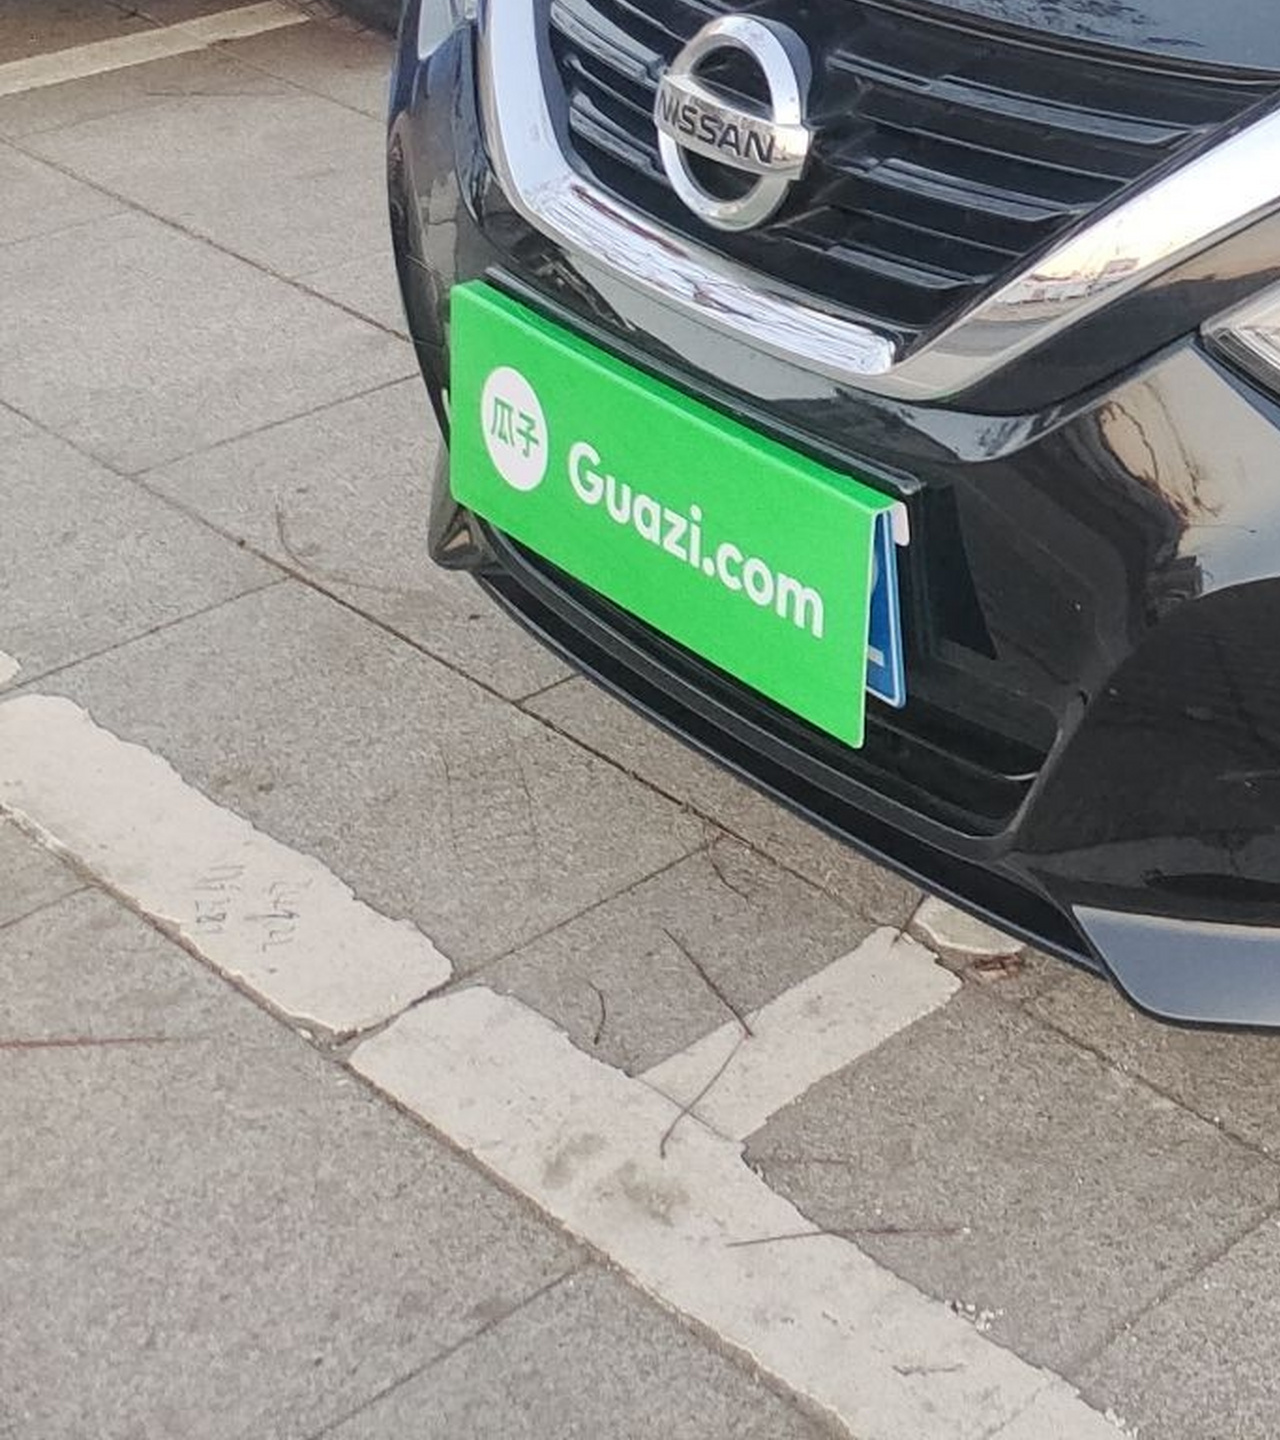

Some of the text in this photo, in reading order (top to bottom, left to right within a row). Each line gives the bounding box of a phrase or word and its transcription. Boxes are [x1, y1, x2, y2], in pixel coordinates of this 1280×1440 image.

[655, 86, 776, 166] NISSAN
[489, 394, 541, 460] 瓜子
[567, 442, 826, 639] Guazi.com
